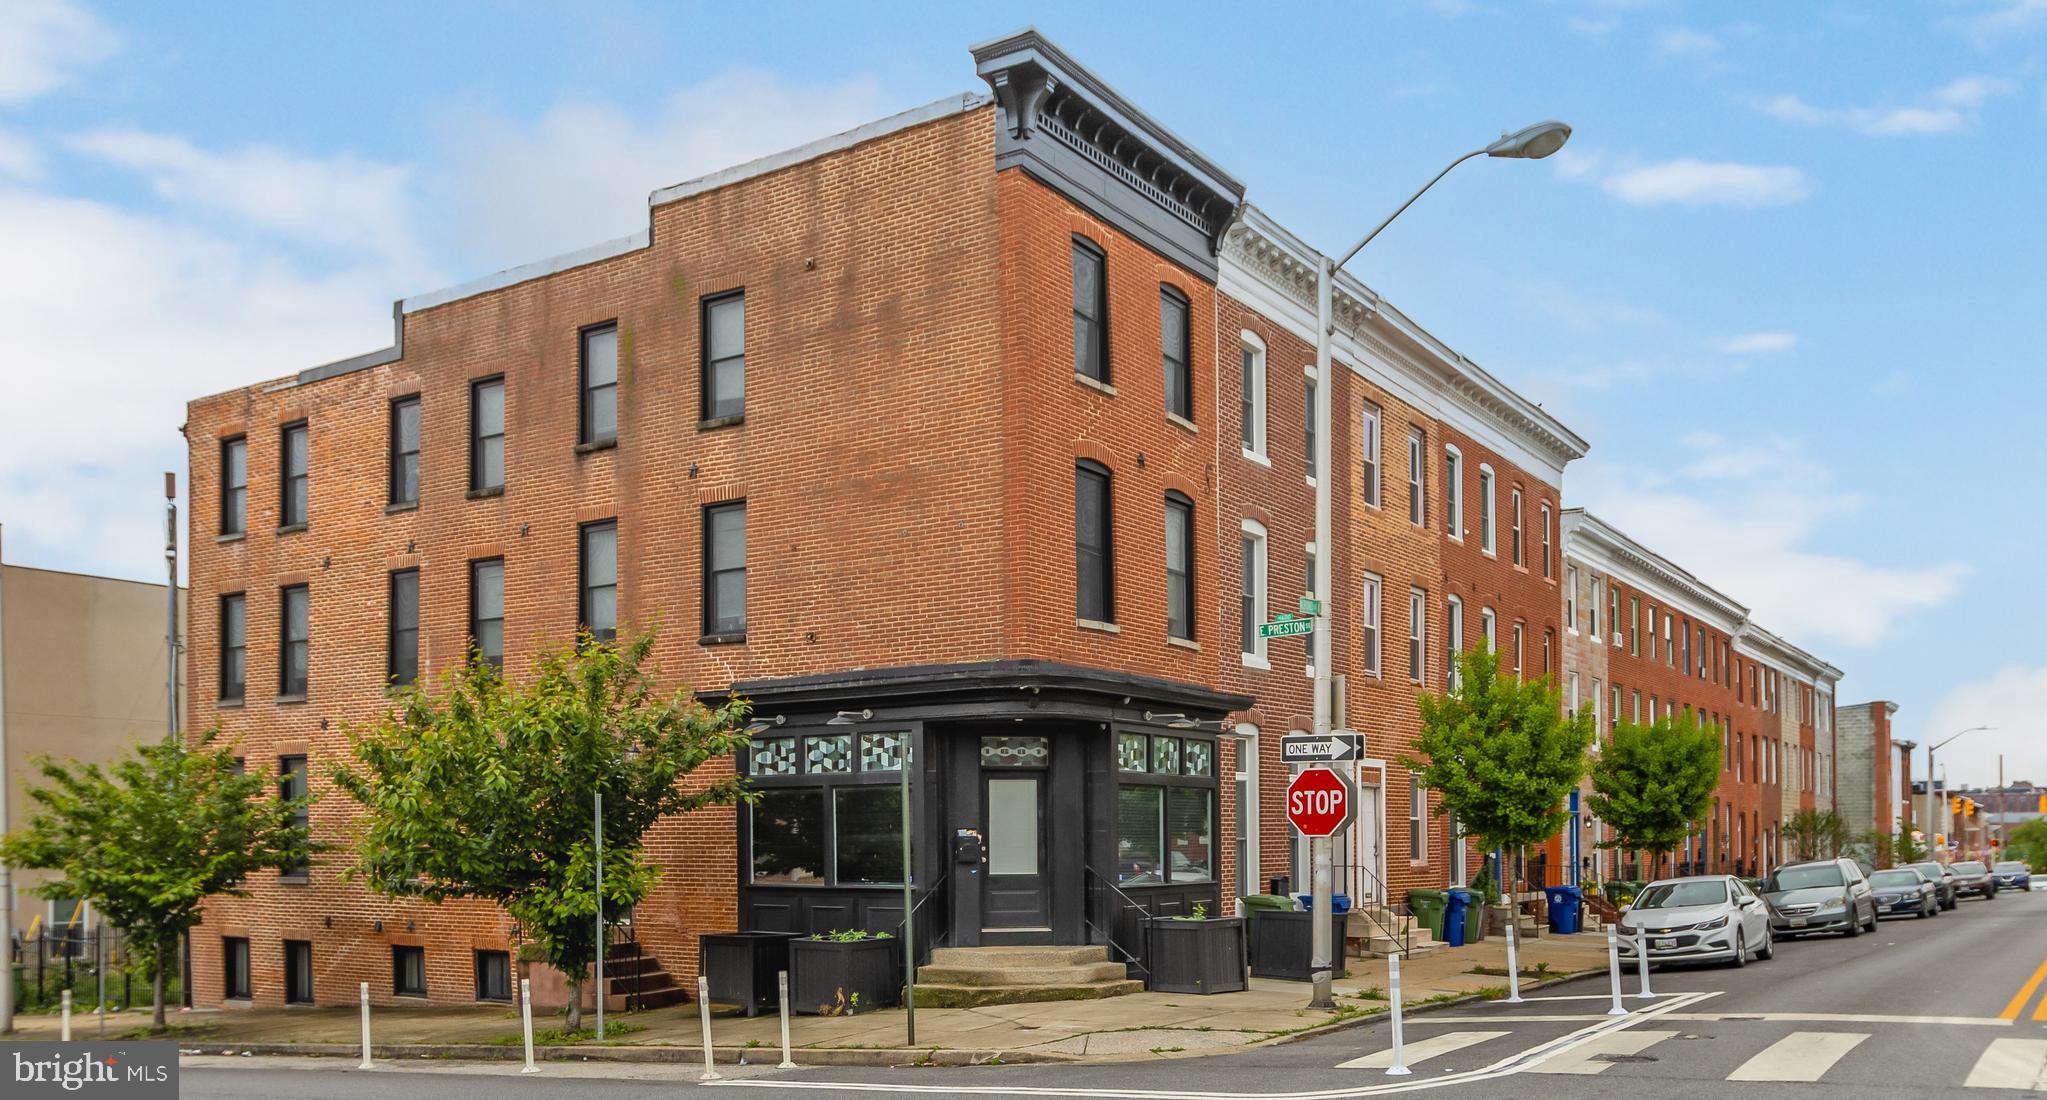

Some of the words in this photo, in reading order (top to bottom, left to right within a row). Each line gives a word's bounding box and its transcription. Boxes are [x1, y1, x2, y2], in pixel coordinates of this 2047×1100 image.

[1260, 626, 1266, 636] E
[1268, 622, 1305, 635] PRESTON
[1288, 744, 1308, 754] ONE
[1311, 743, 1332, 754] WAY
[1291, 789, 1343, 815] STOP
